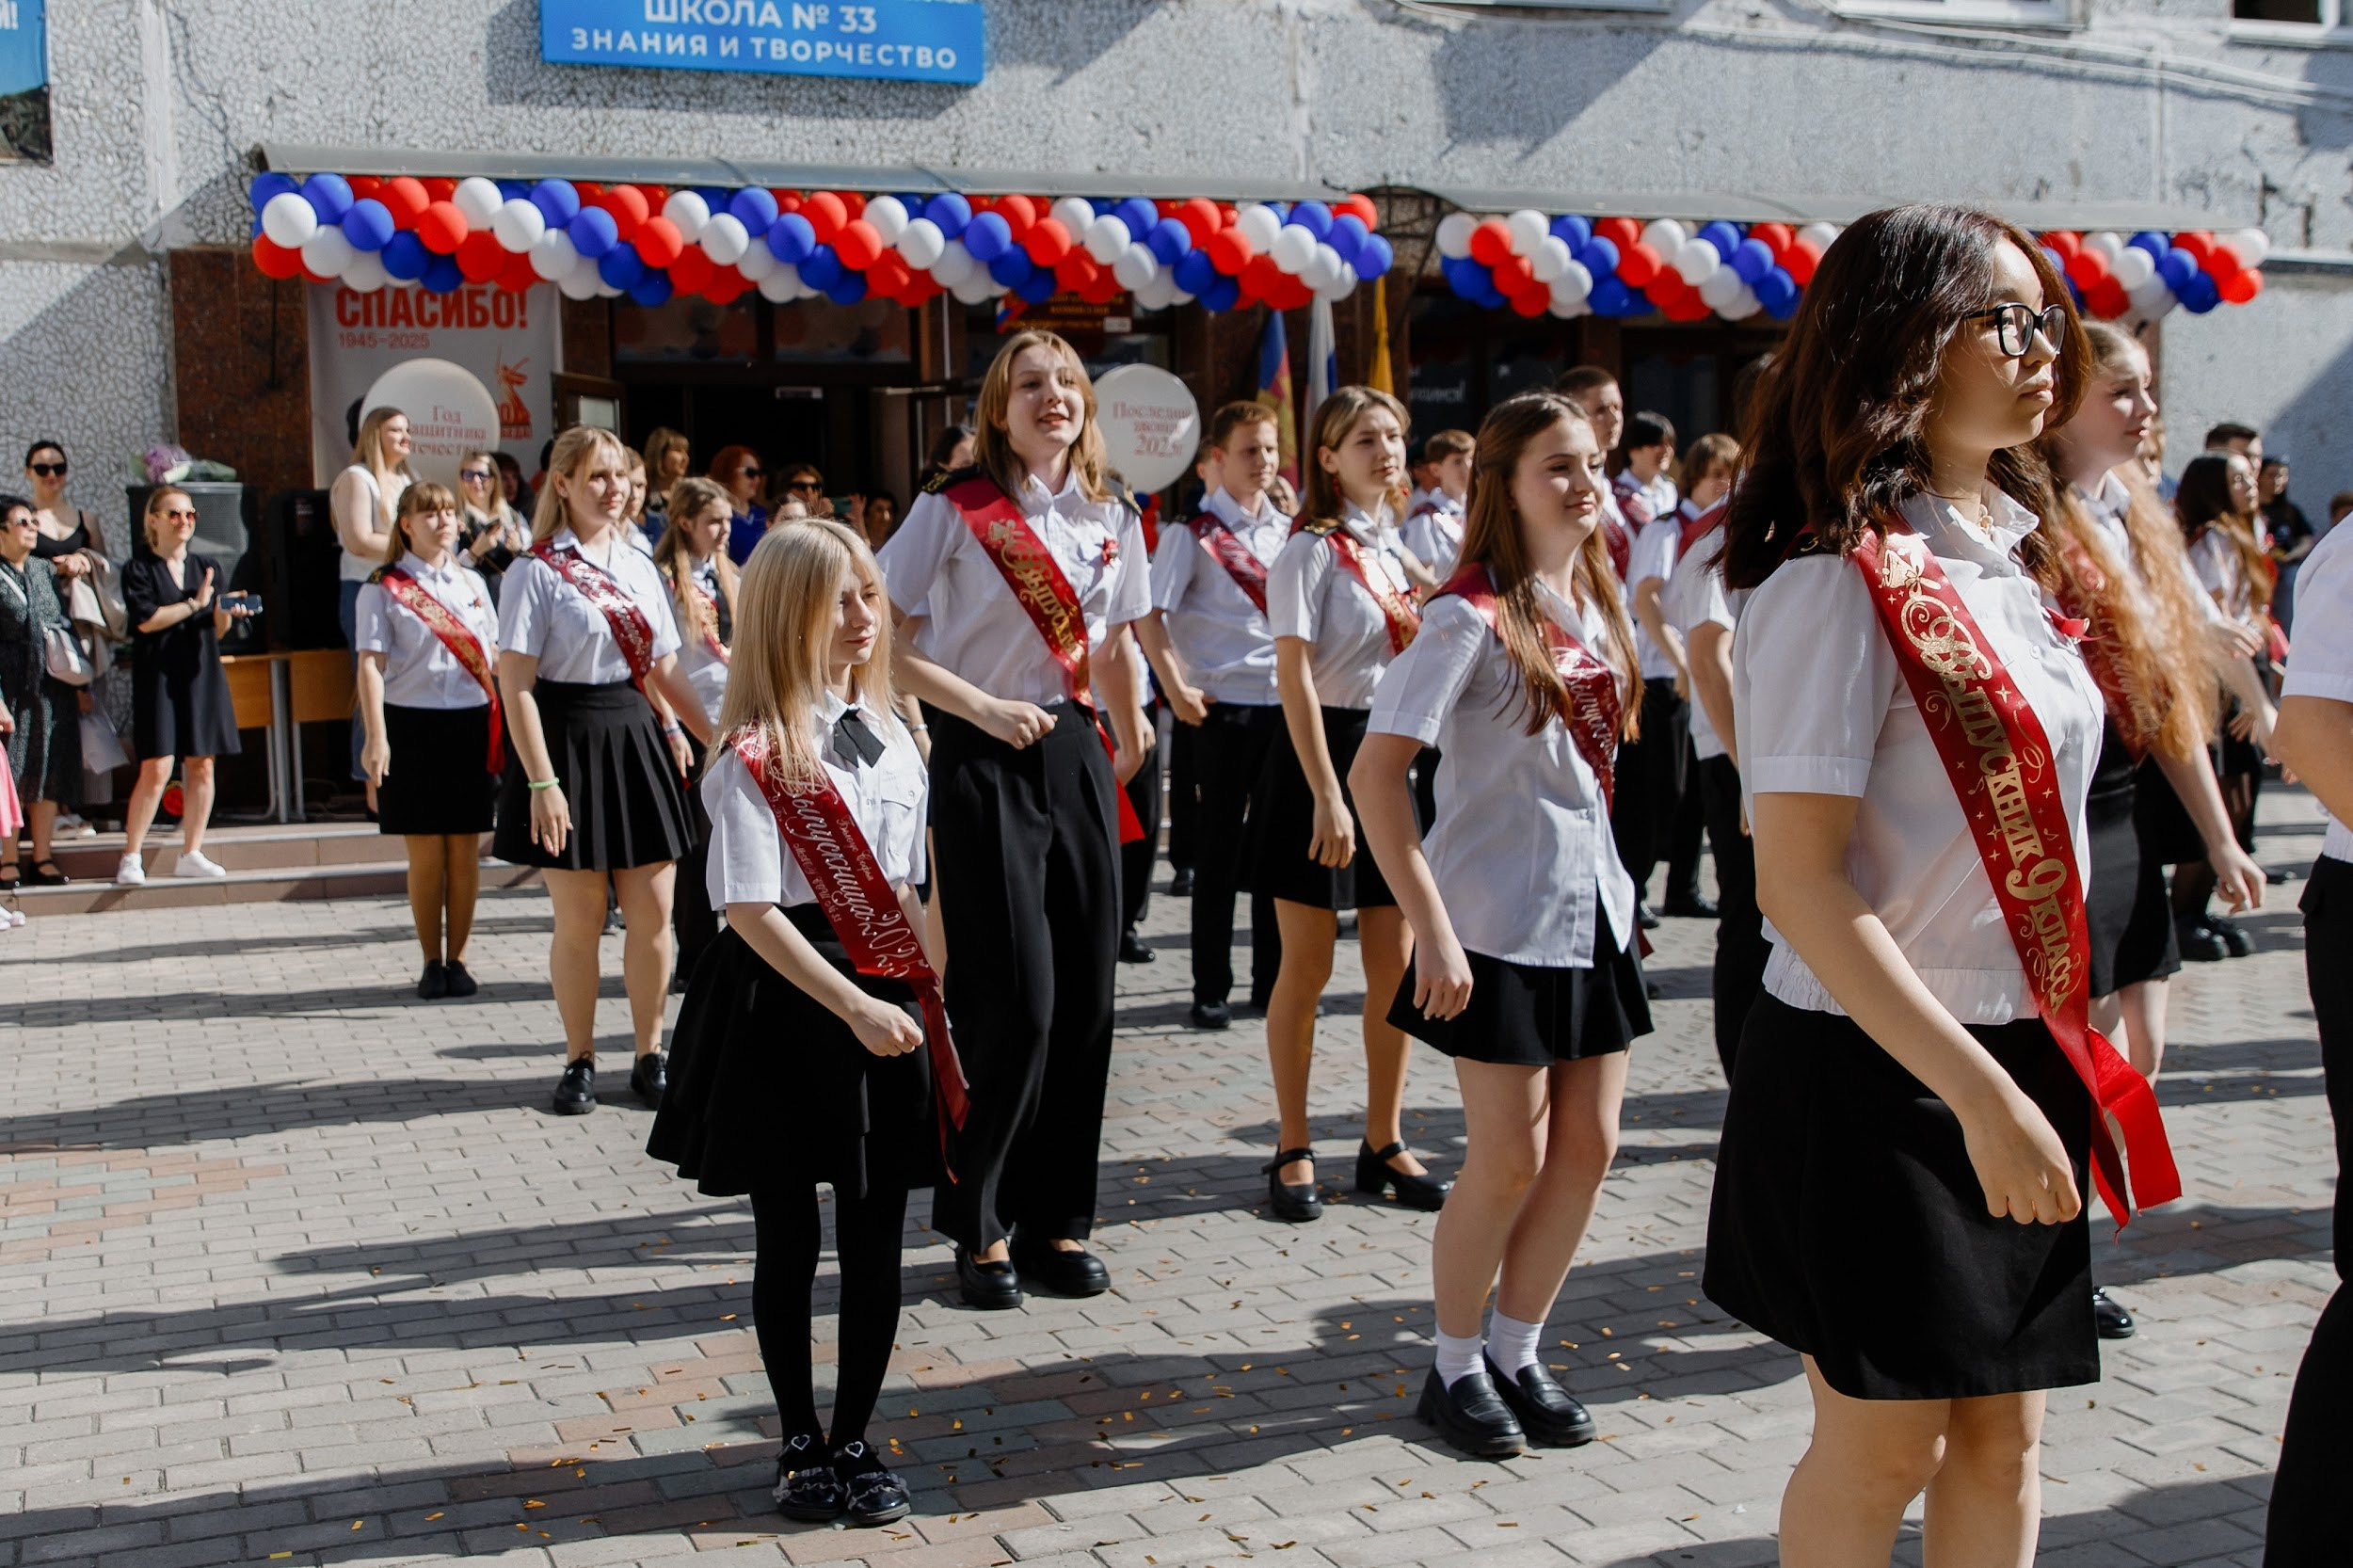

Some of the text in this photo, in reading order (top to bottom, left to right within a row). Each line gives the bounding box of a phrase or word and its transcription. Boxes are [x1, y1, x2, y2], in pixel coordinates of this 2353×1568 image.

[645, 0, 877, 34] ШКОЛА № 33
[571, 27, 957, 70] ЗНАНИЯ И ТВОРЧЕСТВО
[335, 285, 529, 329] СПАСИБО!
[338, 331, 431, 350] 1945-2025
[410, 424, 488, 440] ащитника
[858, 909, 929, 978] 2025
